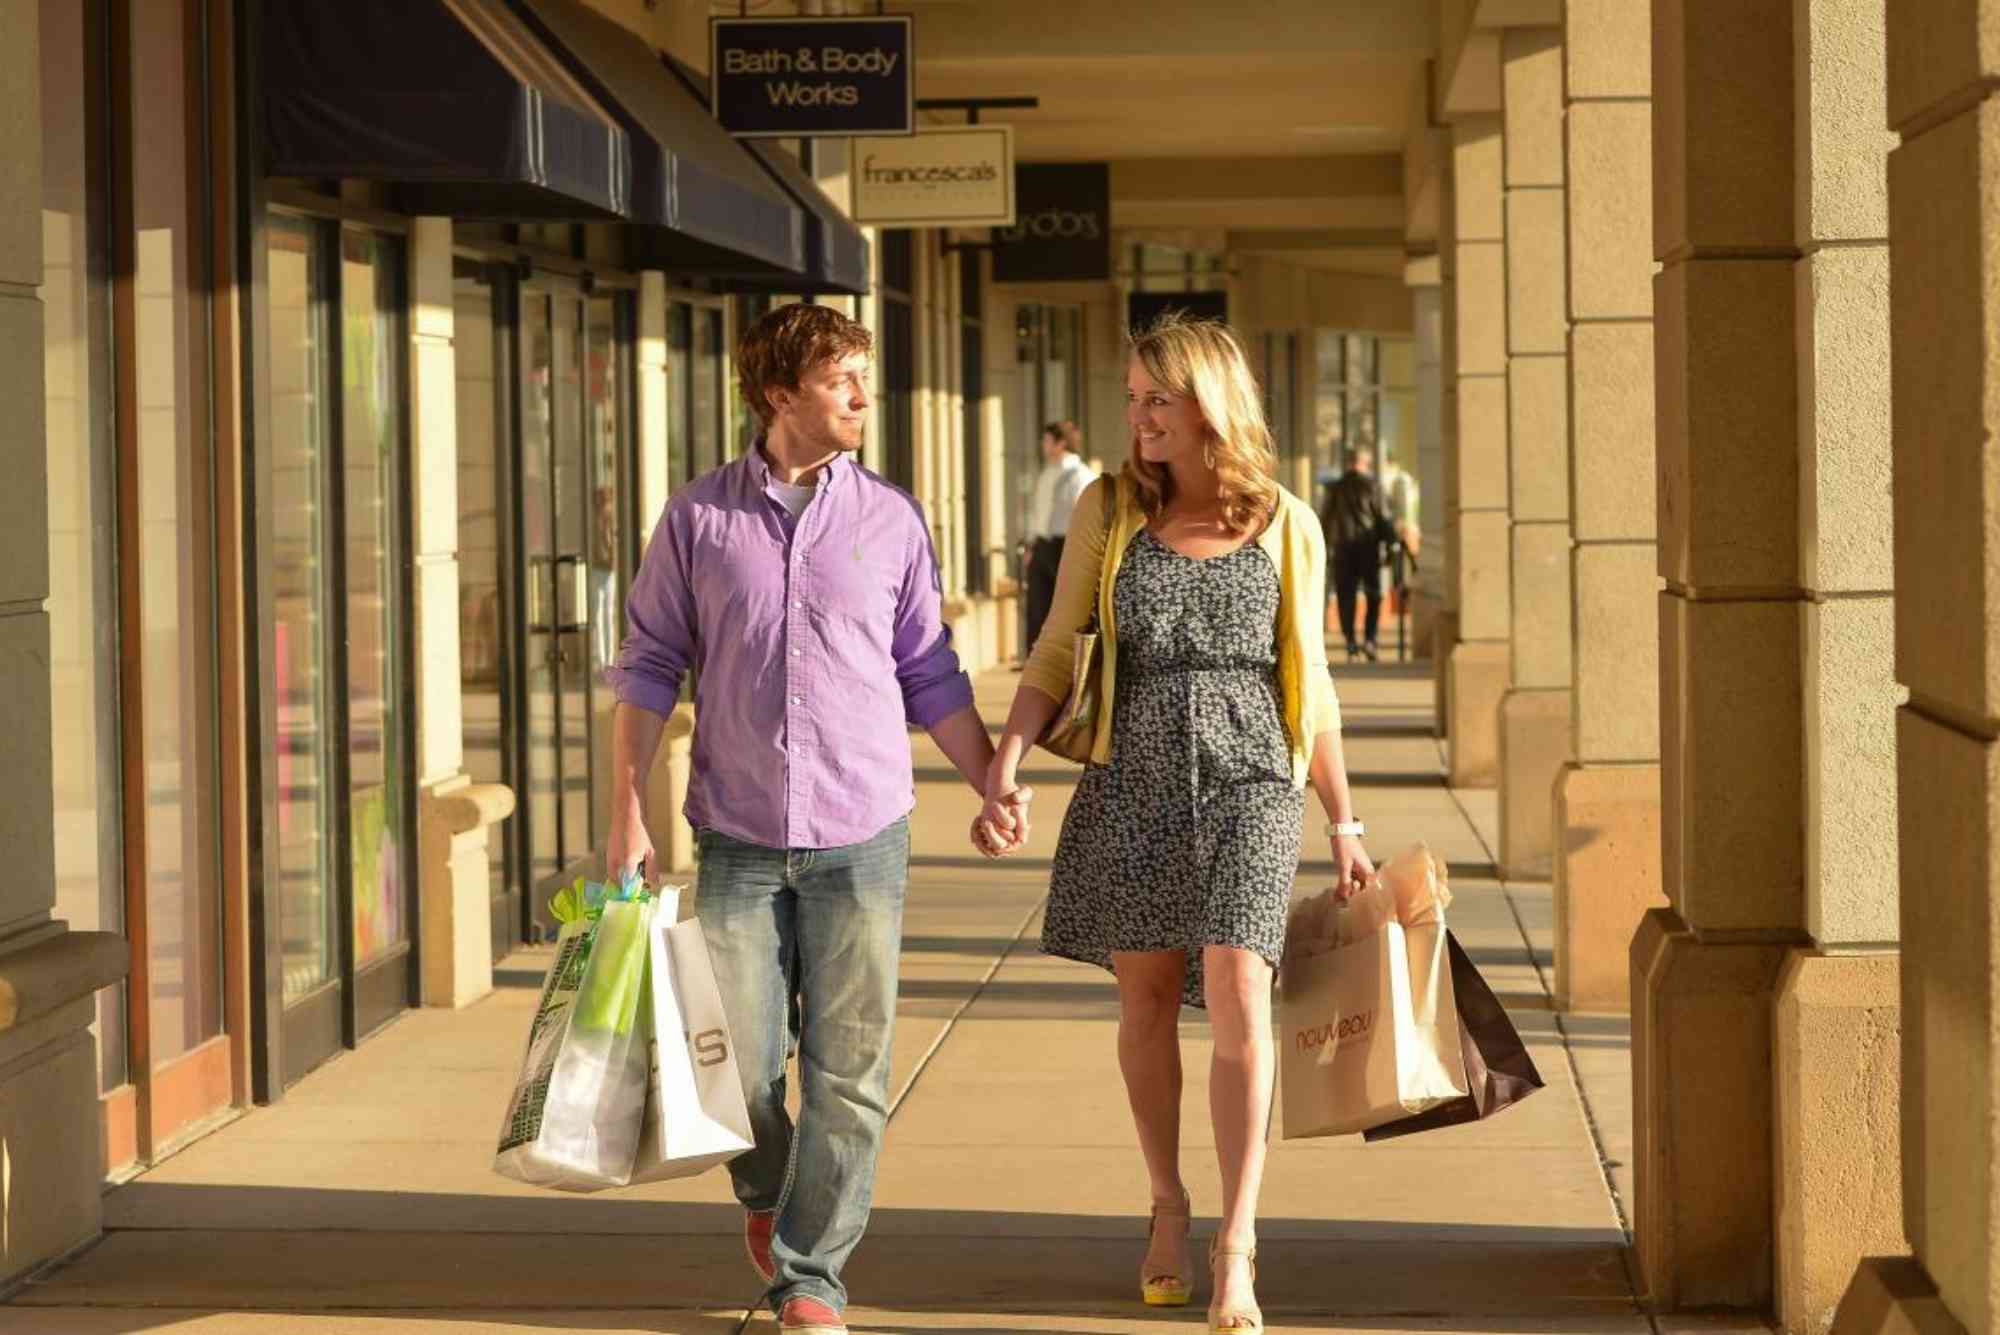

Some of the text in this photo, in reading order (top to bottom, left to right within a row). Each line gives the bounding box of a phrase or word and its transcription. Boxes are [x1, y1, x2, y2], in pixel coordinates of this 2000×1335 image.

[725, 46, 897, 76] Bath & Body
[767, 82, 859, 105] Works
[863, 154, 997, 184] francesca's
